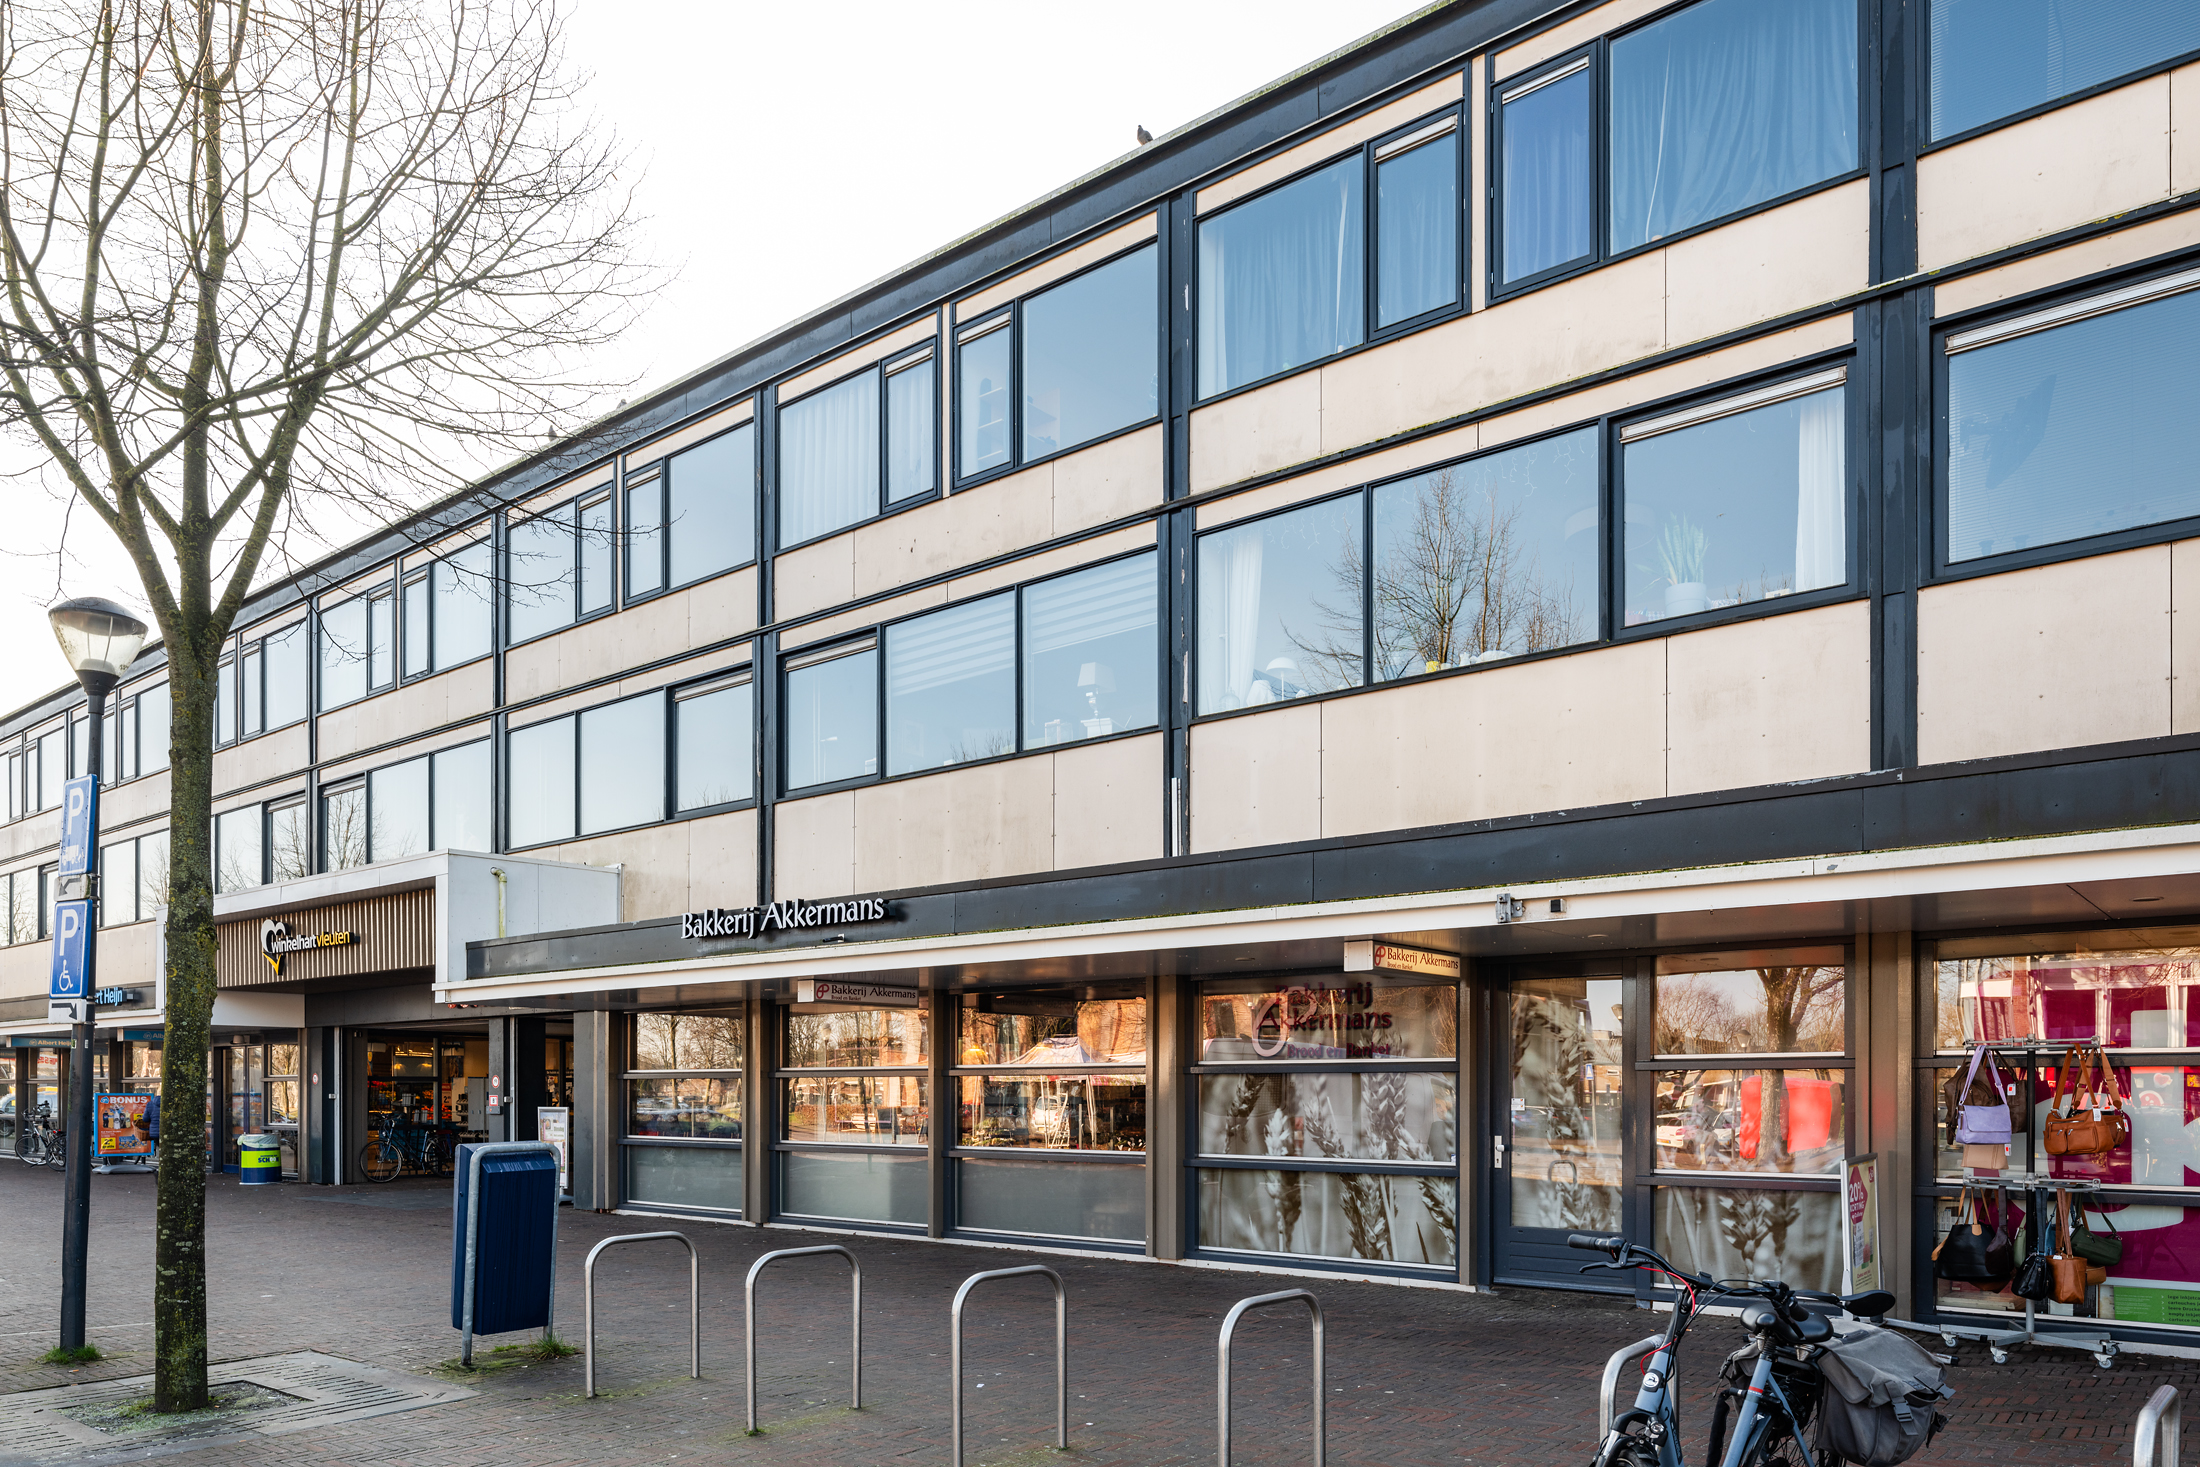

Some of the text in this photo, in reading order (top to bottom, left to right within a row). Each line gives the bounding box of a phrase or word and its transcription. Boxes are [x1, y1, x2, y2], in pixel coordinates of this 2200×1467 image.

[68, 787, 84, 835] P
[681, 897, 884, 939] Bakkerij Akkermans
[59, 908, 79, 957] P
[1387, 947, 1459, 970] Bakkerij Akkermans
[104, 986, 123, 1006] Heijn
[831, 984, 916, 999] Bakkerij Akkermans
[1256, 981, 1392, 1031] Bakkerij Akkermans
[1287, 1041, 1391, 1059] Brood en Banket
[110, 1096, 148, 1104] BONUS
[1849, 1181, 1864, 1203] 20%
